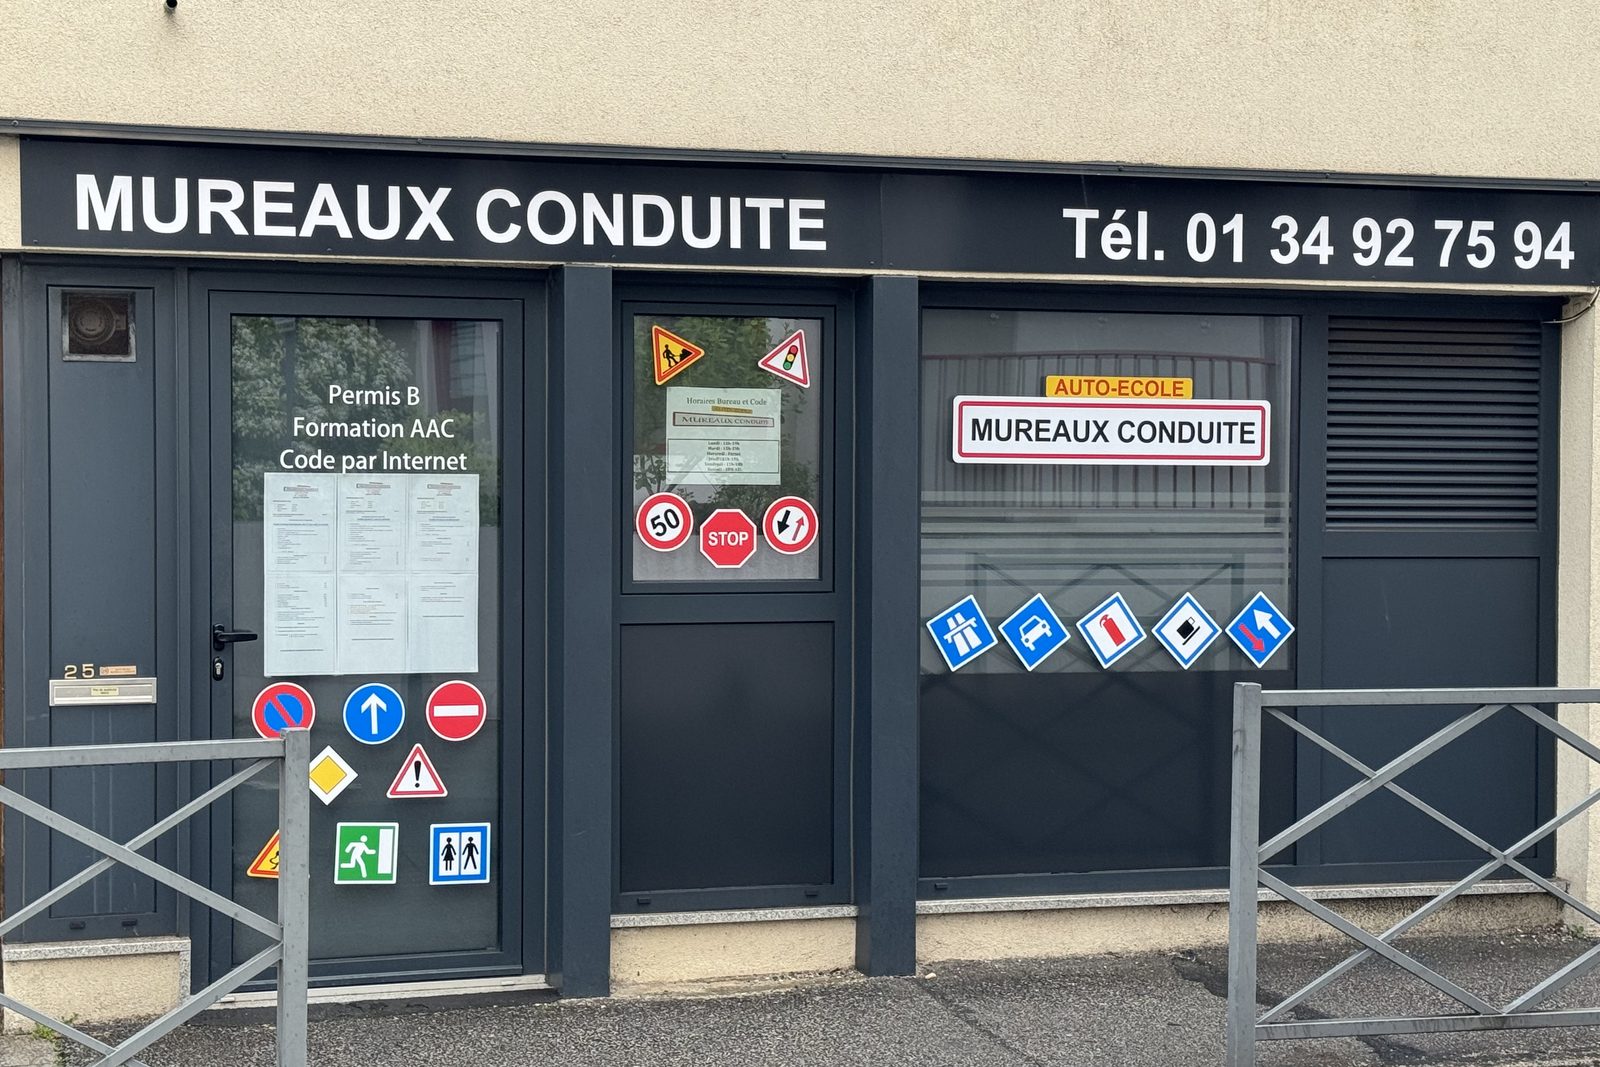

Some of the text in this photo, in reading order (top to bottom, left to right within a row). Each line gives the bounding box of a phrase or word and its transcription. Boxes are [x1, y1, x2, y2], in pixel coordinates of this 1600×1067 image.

[76, 173, 827, 251] MUREAUX CONDUITE
[1062, 207, 1575, 270] Tél. 01 34 92 75 94
[329, 385, 420, 406] Permis B
[1054, 378, 1184, 397] AUTO-ECOLE
[686, 397, 715, 405] Horaires
[717, 397, 741, 405] Bureau
[750, 398, 768, 406] Code
[293, 416, 455, 439] Formation AAC
[682, 416, 733, 425] MUREAUX
[971, 418, 1256, 445] MUREAUX CONDUITE
[279, 449, 468, 474] Code par Internet
[650, 508, 680, 537] 50
[708, 531, 749, 547] STOP
[64, 663, 95, 680] 25
